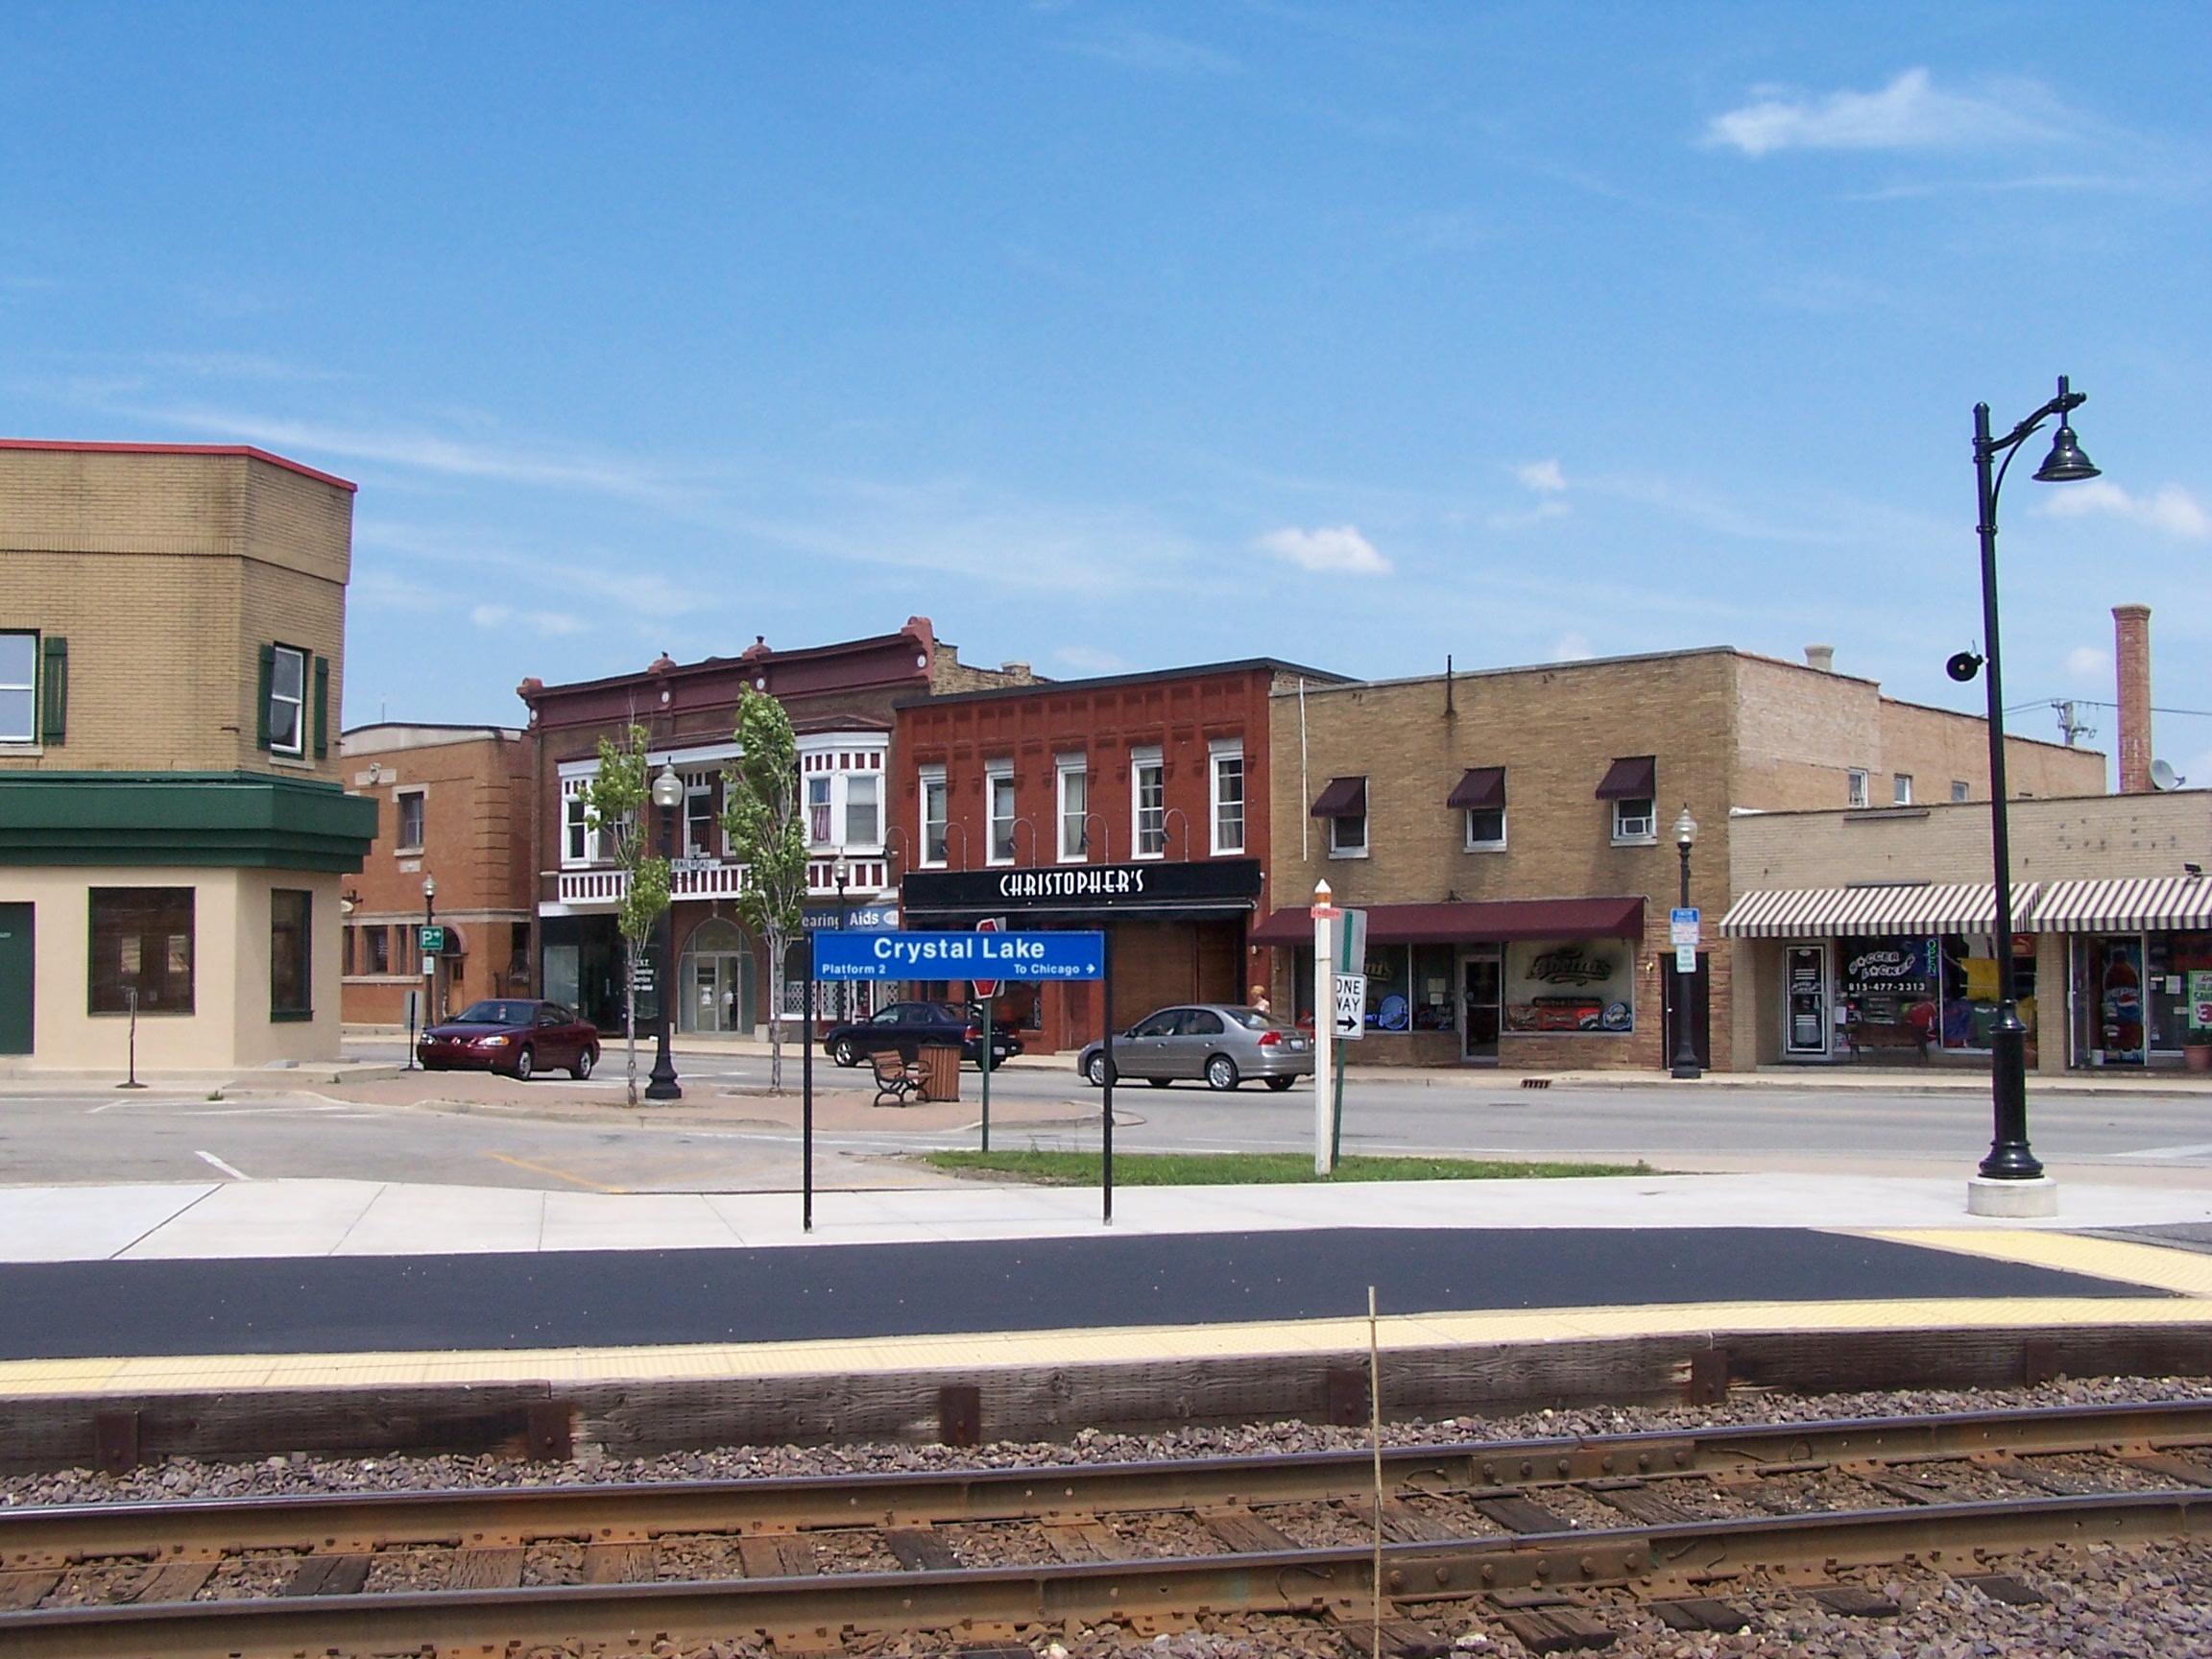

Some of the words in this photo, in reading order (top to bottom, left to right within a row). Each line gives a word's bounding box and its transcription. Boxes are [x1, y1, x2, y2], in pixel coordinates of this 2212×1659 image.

[999, 869, 1143, 897] CHRISTOPHER'S
[850, 911, 879, 926] Aids
[874, 937, 973, 963] Crystal
[982, 938, 1045, 958] Lake
[822, 963, 875, 974] Platform
[878, 964, 886, 974] 2
[1014, 964, 1027, 974] To
[1030, 963, 1080, 975] Chicago
[1336, 979, 1360, 995] ONE
